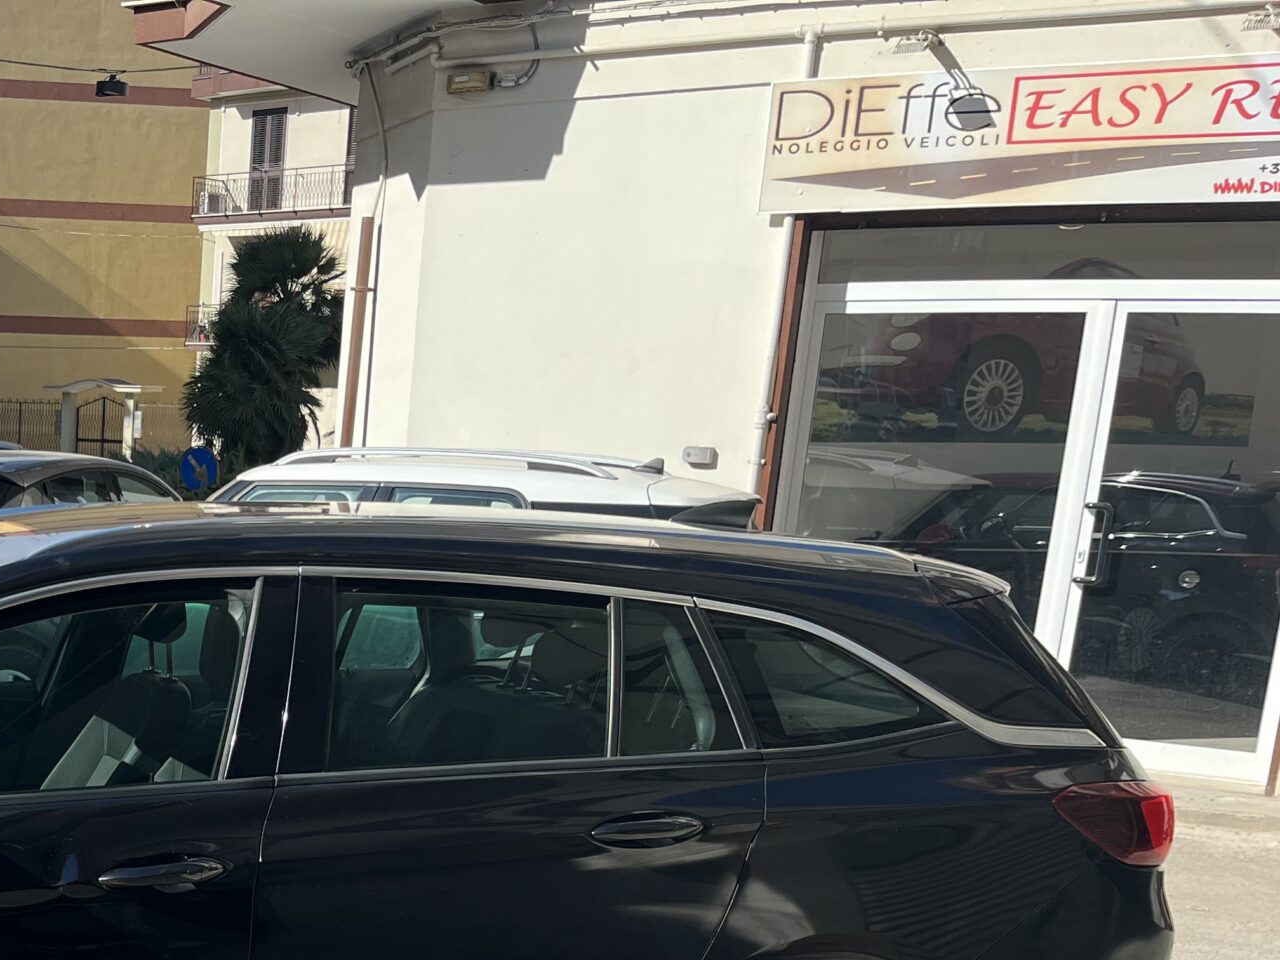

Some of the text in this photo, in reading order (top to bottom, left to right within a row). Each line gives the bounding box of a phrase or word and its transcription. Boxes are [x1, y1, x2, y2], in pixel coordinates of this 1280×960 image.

[1025, 82, 1193, 130] EASY
[772, 134, 1000, 155] NOLEGGIO VEICOLI
